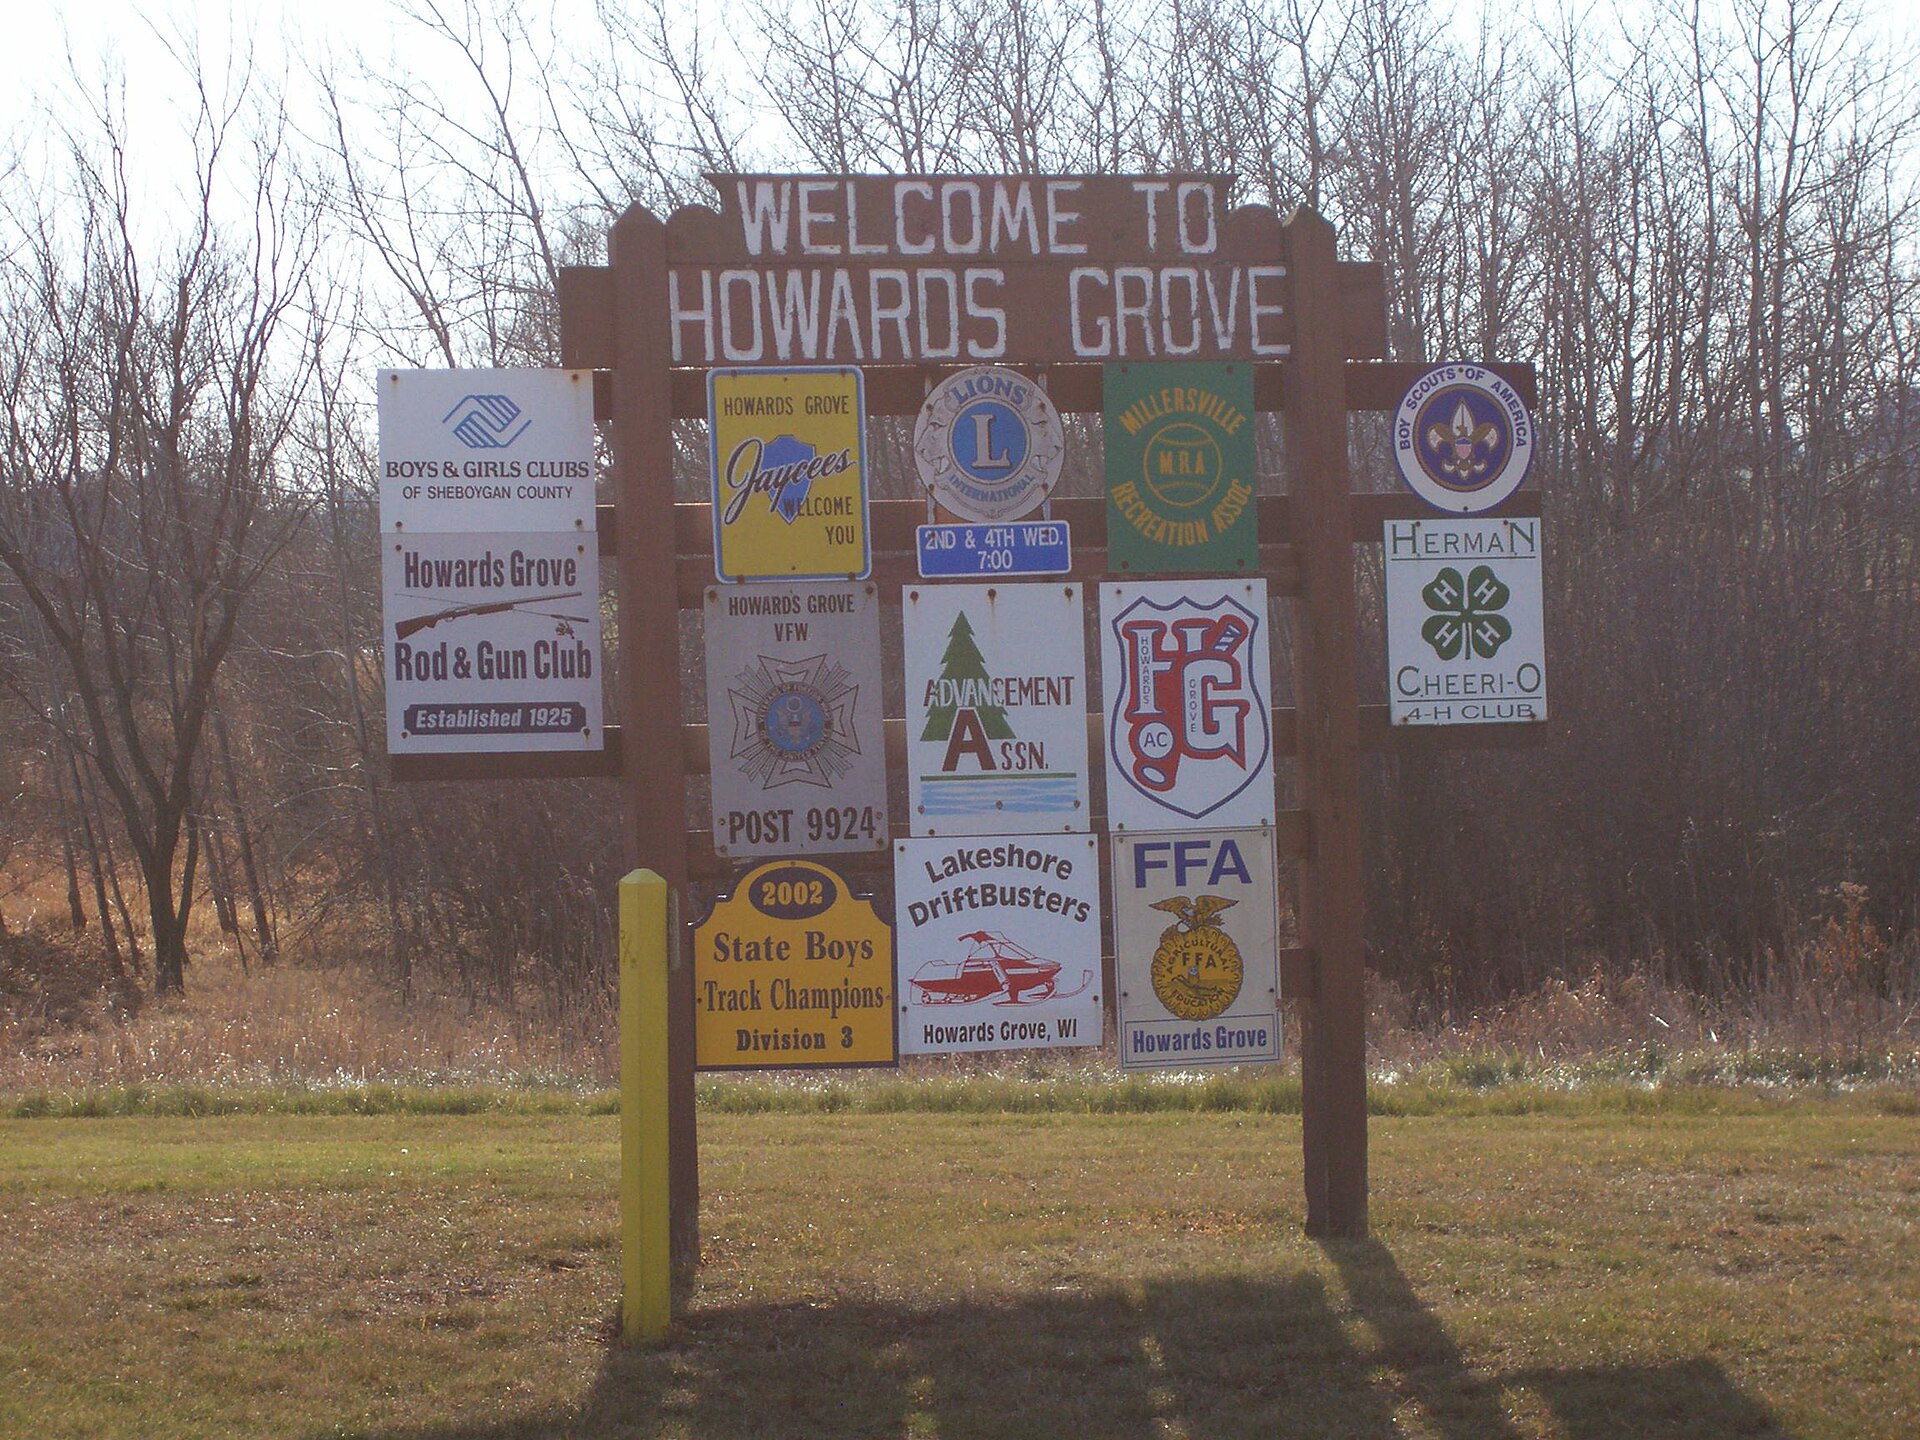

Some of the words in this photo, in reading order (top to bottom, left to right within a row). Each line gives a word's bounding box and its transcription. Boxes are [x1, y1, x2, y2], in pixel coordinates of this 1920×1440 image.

[737, 181, 1087, 255] WELCOME
[1133, 181, 1218, 254] TO
[668, 267, 1005, 362] HOWARDS
[1070, 266, 1291, 358] GROVE
[951, 375, 1028, 405] LIONS
[724, 397, 794, 416] HOWARDS
[805, 395, 849, 415] GROVE
[1119, 387, 1247, 436] MILLERSVILLE
[1399, 419, 1411, 450] BOY
[1406, 368, 1456, 410] SCOUTS
[1465, 368, 1485, 380] OF
[1490, 381, 1527, 447] AMERICA
[970, 414, 1011, 469] L
[386, 461, 438, 478] BOYS
[443, 461, 459, 478] &
[464, 461, 521, 478] GIRLS
[526, 461, 589, 478] CLUBS
[724, 437, 857, 525] Jaycees
[403, 486, 421, 499] OF
[427, 486, 511, 499] SHEBOYGAN
[517, 486, 573, 499] COUNTY
[949, 474, 1035, 501] INTERNATIONAL
[784, 497, 853, 516] WELCOME
[1111, 481, 1209, 546] RECREATION
[825, 526, 854, 545] YOU
[925, 530, 956, 550] 2ND
[965, 530, 976, 548] &
[985, 529, 1014, 547] 4TH
[1023, 528, 1063, 546] WED.
[405, 551, 505, 588] Howards
[510, 550, 576, 587] Grove
[978, 550, 1013, 570] 7:00
[729, 596, 800, 616] HOWARDS
[807, 594, 855, 614] GROVE
[774, 623, 809, 642] VFW
[395, 642, 448, 681] Rod
[453, 647, 472, 679] &
[477, 641, 527, 680] Gun
[534, 640, 592, 679] Club
[1140, 636, 1152, 705] HOWARDS
[923, 676, 1075, 707] ADVANCEMENT
[1189, 679, 1197, 733] GROVE
[416, 709, 522, 728] Established
[530, 708, 572, 726] 1925
[1407, 706, 1451, 720] 4-H
[1461, 705, 1534, 720] CLUB
[1143, 732, 1168, 748] AC
[729, 810, 793, 844] POST
[807, 806, 876, 842] 9924
[924, 843, 1073, 884] Lakeshore
[1133, 839, 1253, 889] FFA
[762, 881, 824, 906] 2002
[908, 883, 1091, 928] DriftBusters
[713, 932, 791, 962] State
[805, 930, 874, 968] Boys
[1167, 939, 1229, 974] AGRICULTURAL
[1182, 952, 1217, 968] FFA
[704, 979, 762, 1012] Track
[770, 977, 884, 1019] Champions
[736, 1027, 826, 1051] Division
[841, 1026, 853, 1049] 3
[923, 1022, 995, 1044] Howards
[1000, 1020, 1051, 1042] Grove,
[1057, 1018, 1078, 1038] WI
[1133, 1027, 1211, 1053] Howards
[1216, 1025, 1267, 1048] Grove
